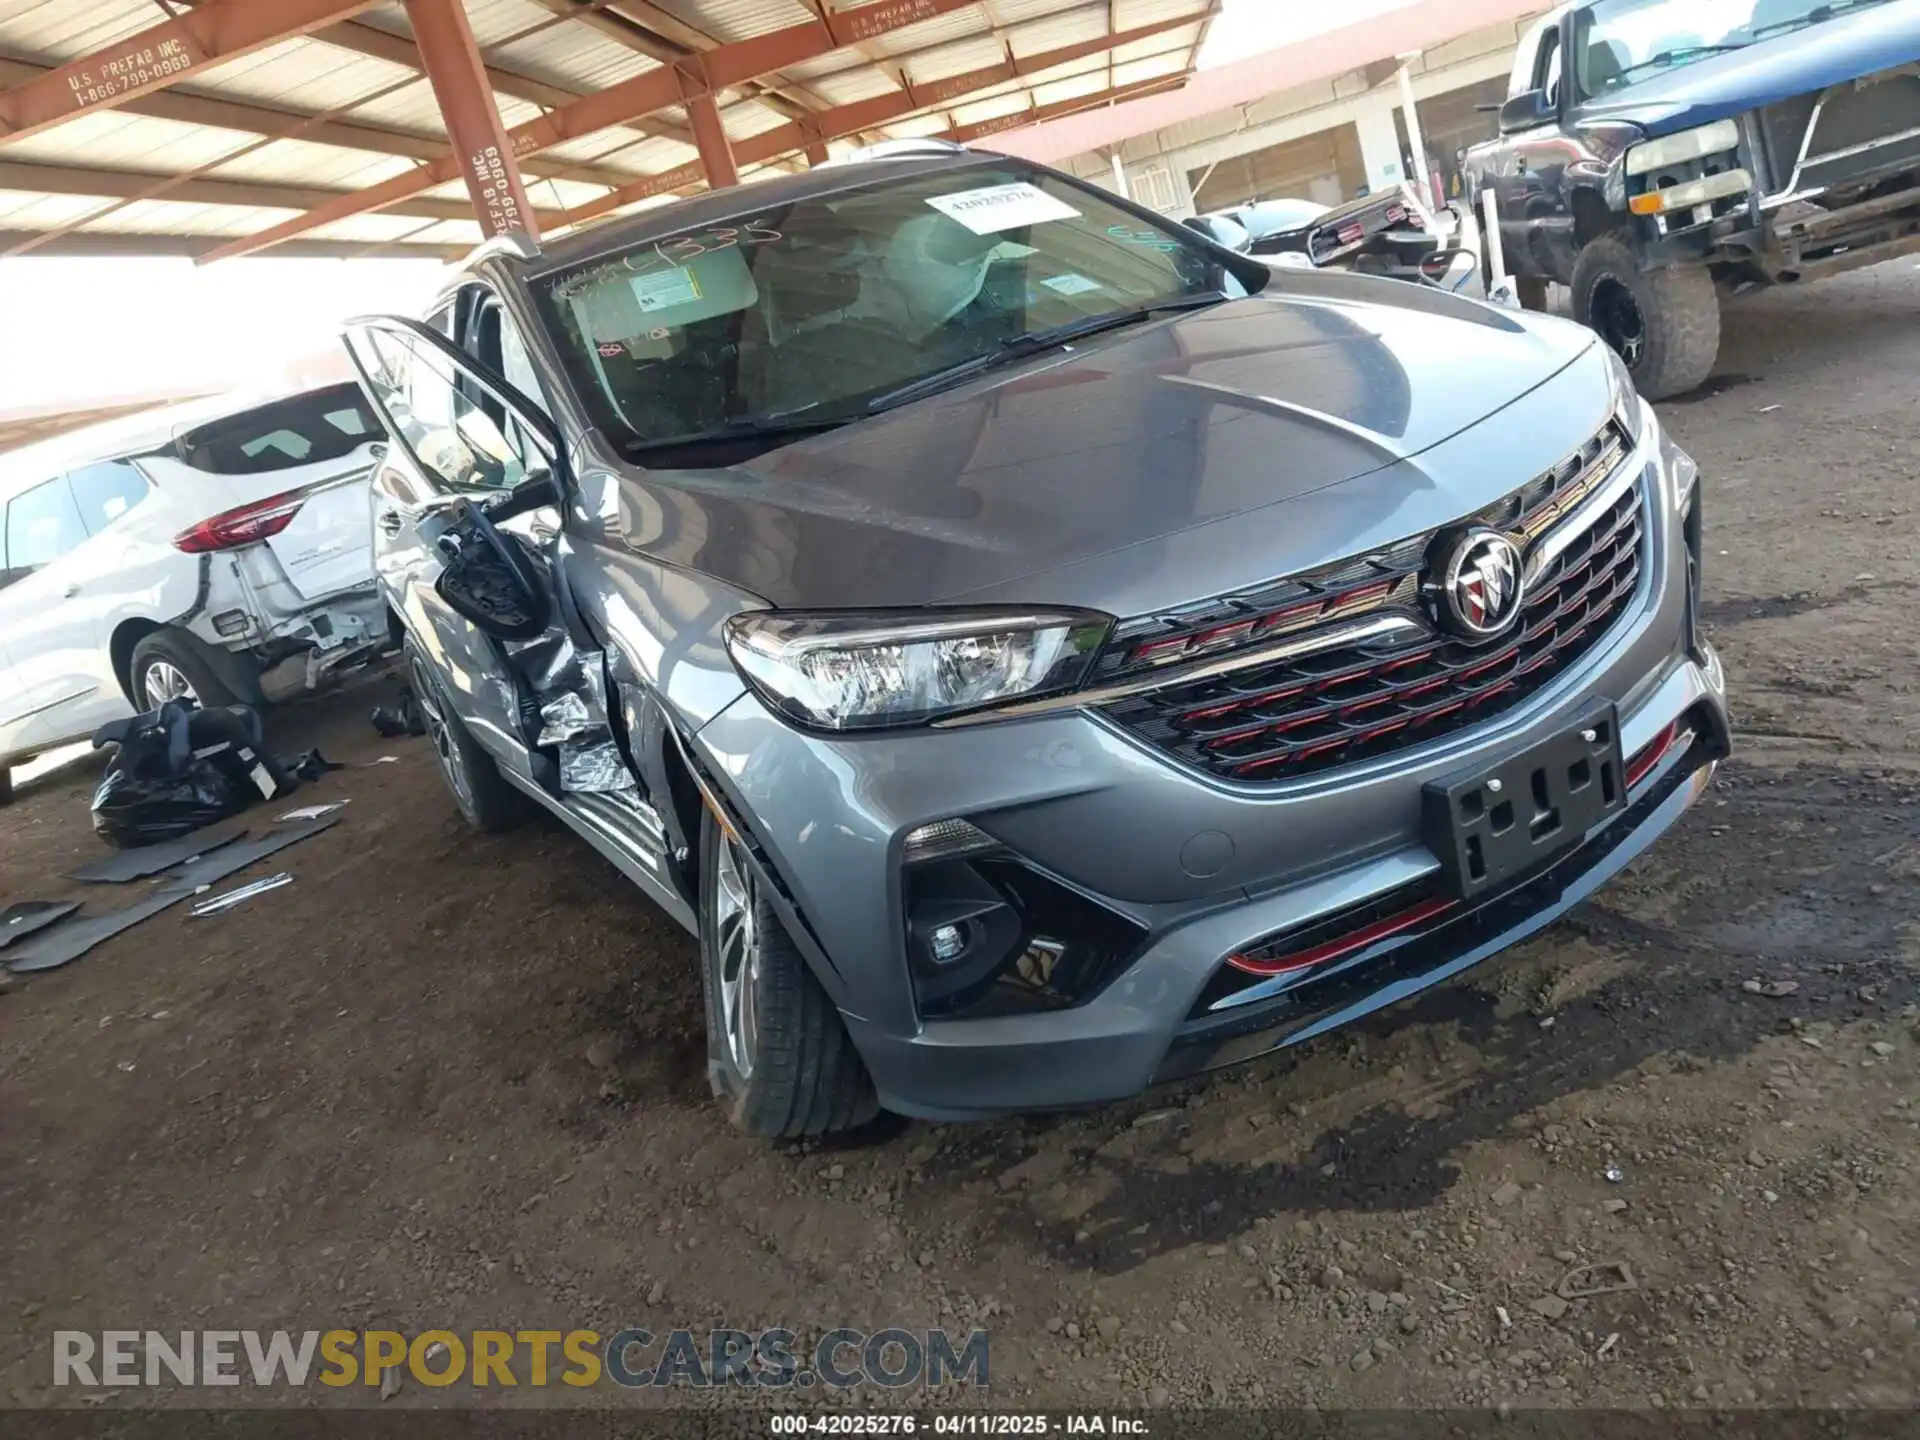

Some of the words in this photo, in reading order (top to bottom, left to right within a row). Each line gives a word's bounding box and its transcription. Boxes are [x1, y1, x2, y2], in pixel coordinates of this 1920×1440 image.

[68, 72, 97, 91] U.S.
[100, 49, 154, 79] PREFAB
[157, 38, 187, 59] INC.
[75, 53, 191, 107] 1-866-799-0969
[472, 149, 491, 182] INC.
